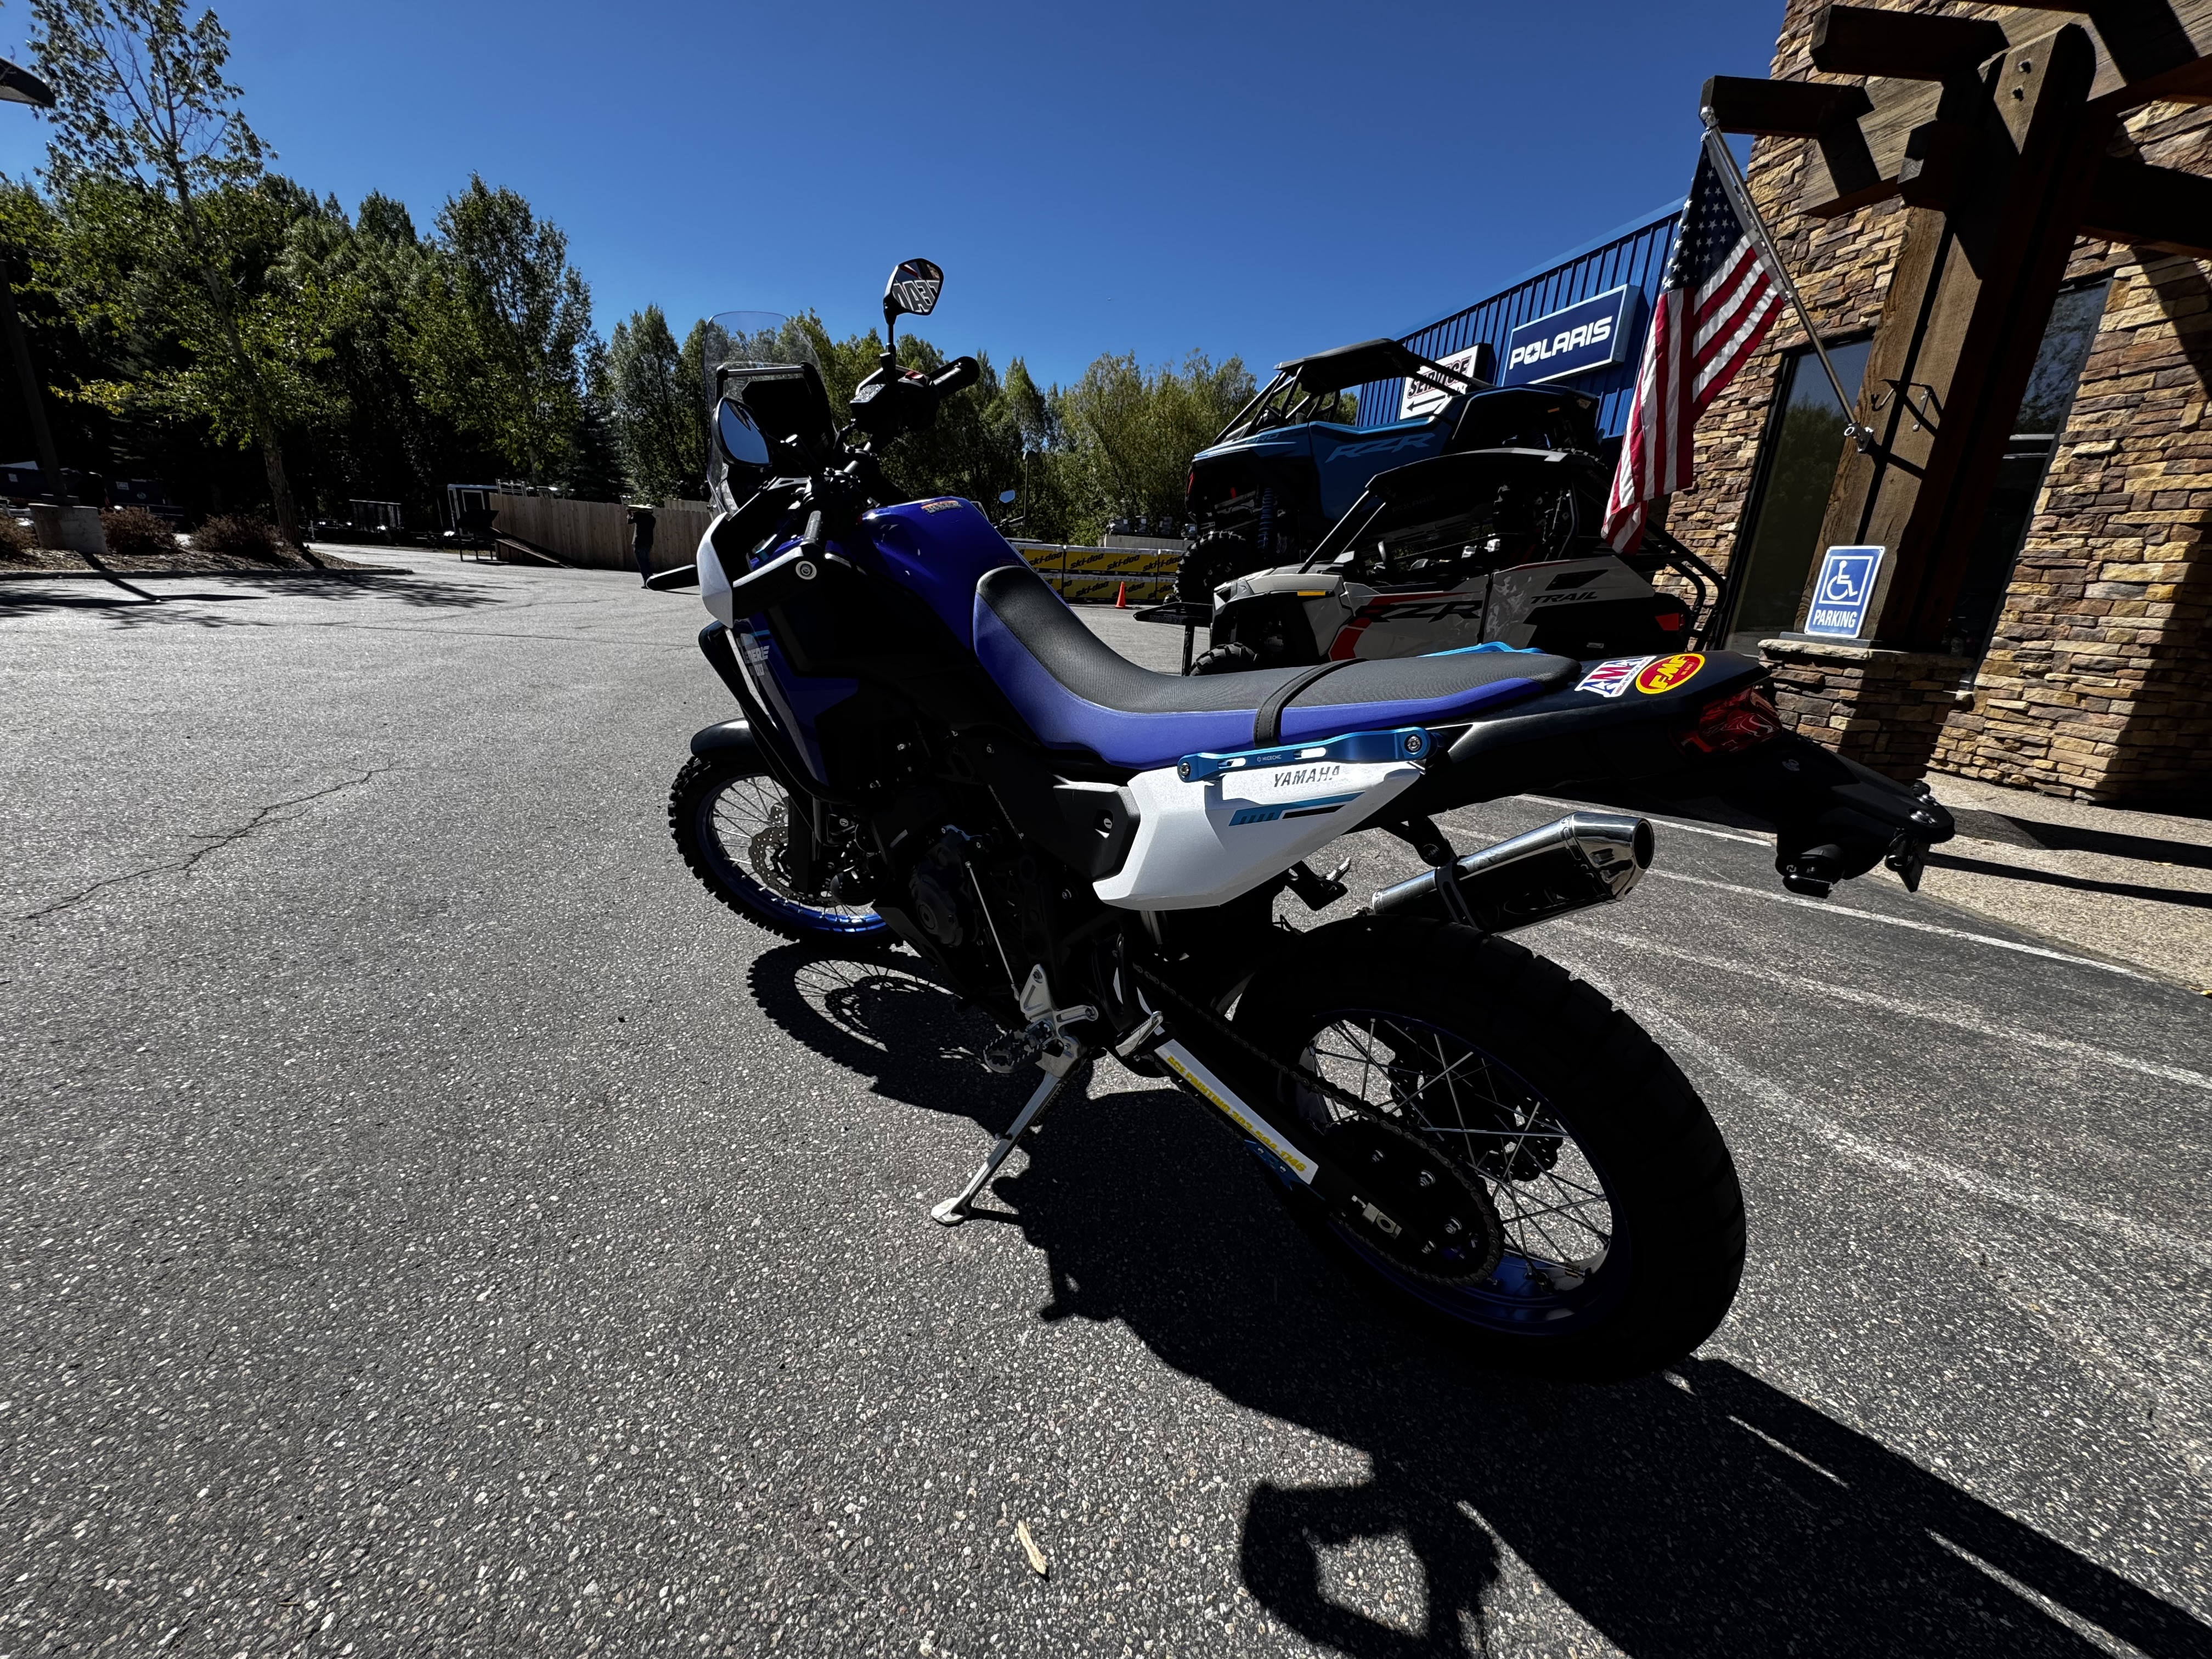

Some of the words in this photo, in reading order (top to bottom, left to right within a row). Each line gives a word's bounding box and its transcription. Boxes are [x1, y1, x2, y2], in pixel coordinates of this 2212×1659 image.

[1509, 315, 1612, 370] POLARIS
[1325, 432, 1436, 464] RZR
[1070, 553, 1104, 569] ski-doo
[1107, 555, 1140, 570] ski-doo
[1531, 591, 1598, 604] TRAIL
[1813, 610, 1857, 628] PARKING
[1580, 658, 1644, 695] AMA
[1649, 656, 1687, 689] FMF
[1274, 765, 1340, 787] YAMAHA
